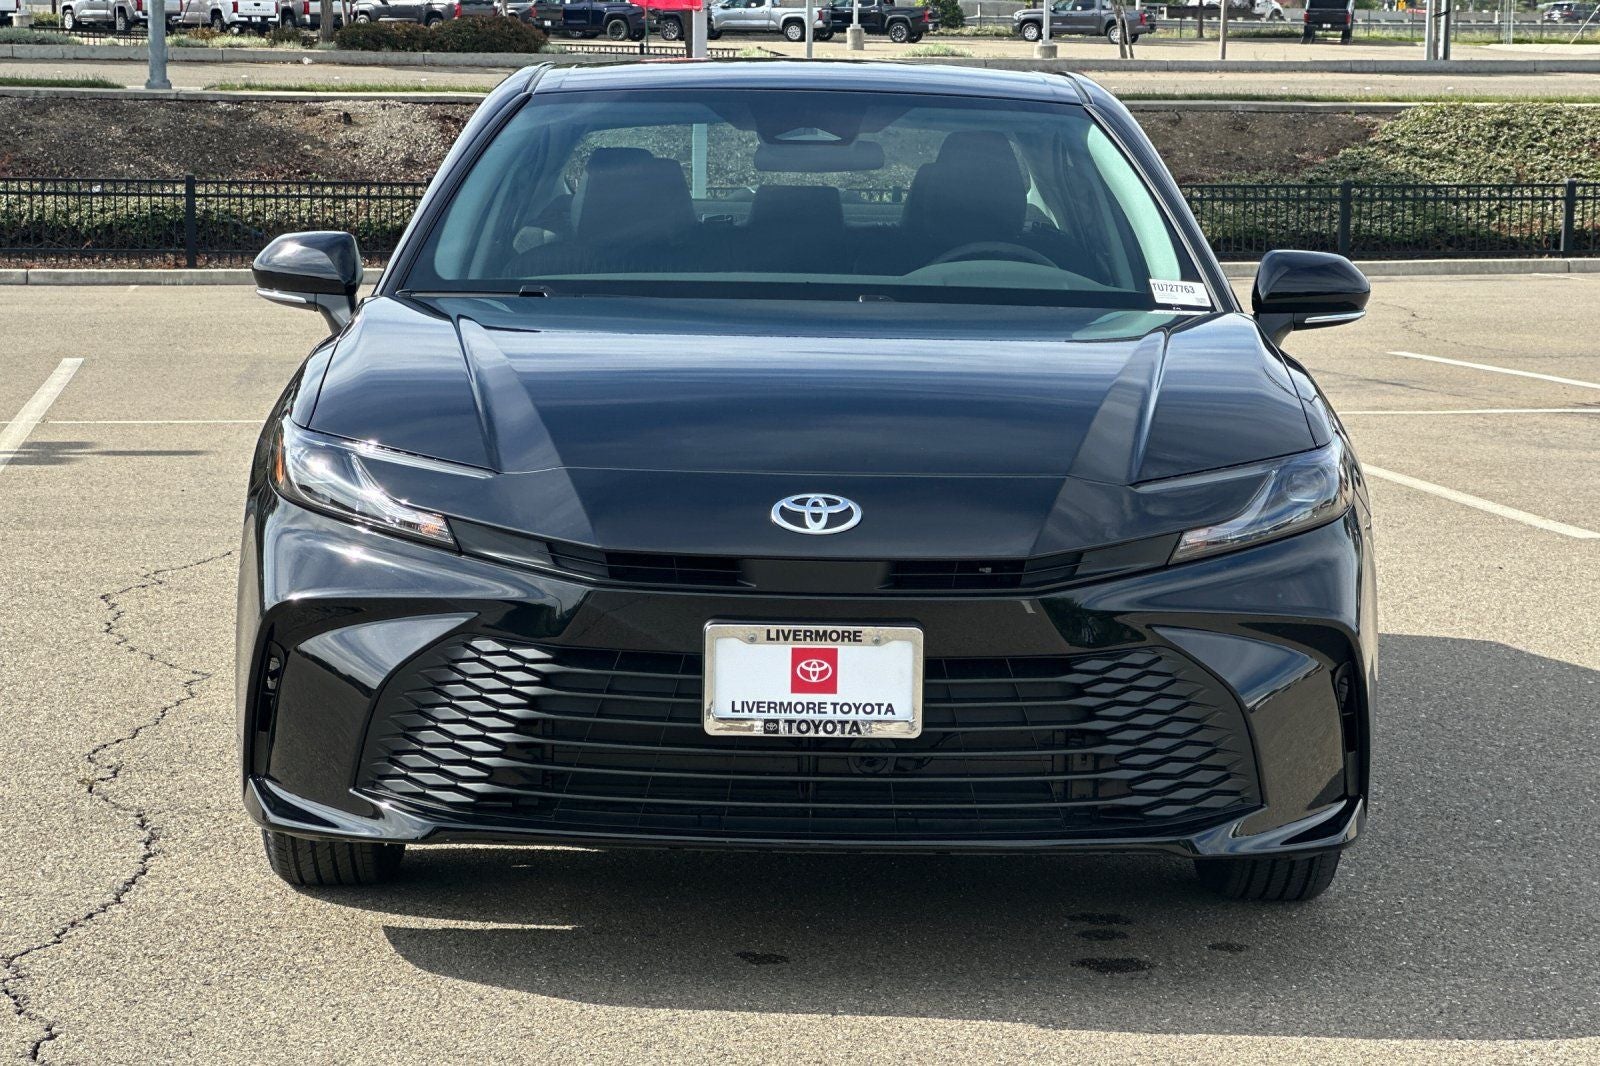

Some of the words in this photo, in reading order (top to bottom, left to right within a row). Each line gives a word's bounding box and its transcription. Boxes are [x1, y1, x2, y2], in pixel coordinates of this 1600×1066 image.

[1152, 283, 1195, 294] TU727763
[766, 629, 862, 643] LIVERMORE
[731, 701, 827, 715] LIVERMORE
[830, 702, 896, 716] TOYOTA
[784, 719, 862, 735] TOYOTA
